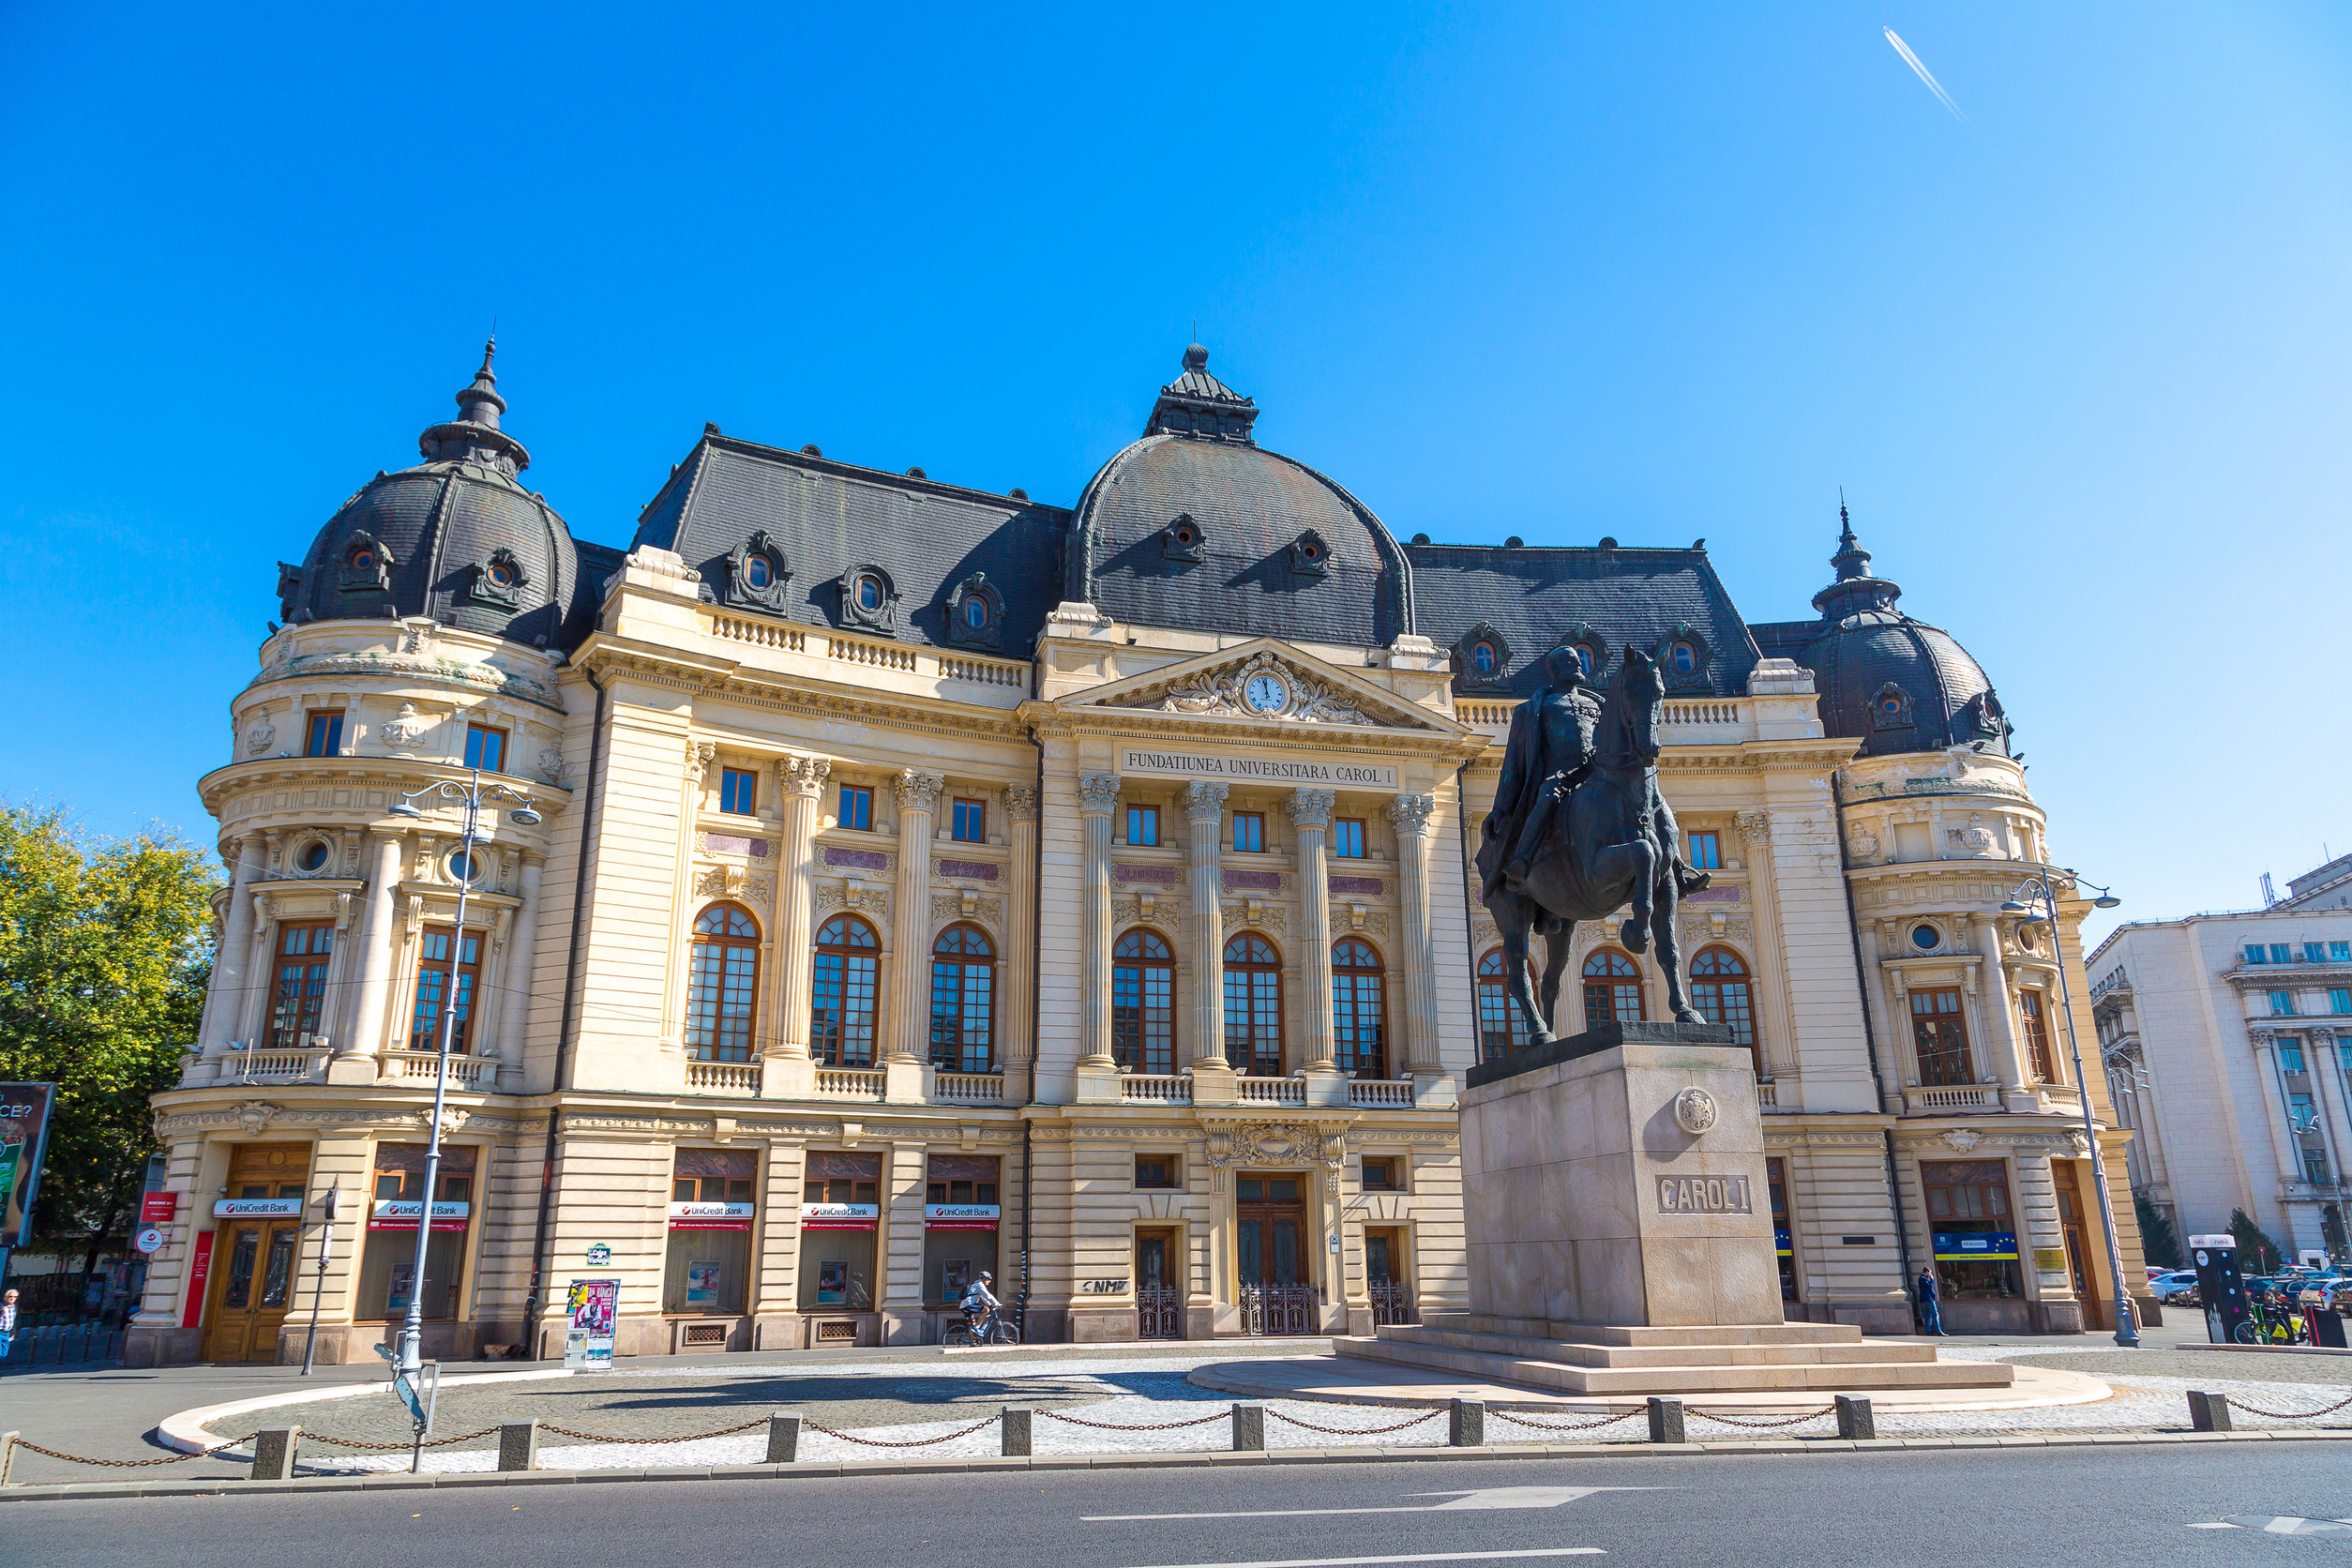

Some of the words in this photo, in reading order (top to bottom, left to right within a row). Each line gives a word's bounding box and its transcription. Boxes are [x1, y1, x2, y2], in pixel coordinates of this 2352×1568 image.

[1128, 752, 1224, 773] FUNDATIUNEA
[1229, 760, 1330, 779] UNIVERSITARA
[1335, 766, 1381, 783] CAROL
[1386, 770, 1392, 783] I
[1660, 1179, 1735, 1210] CAROL
[1737, 1180, 1749, 1210] I
[235, 1203, 269, 1213] UniCredit
[270, 1203, 290, 1213] Bank
[437, 1206, 457, 1214] Bank
[943, 1208, 973, 1216] UniCredit
[973, 1208, 990, 1216] Bank
